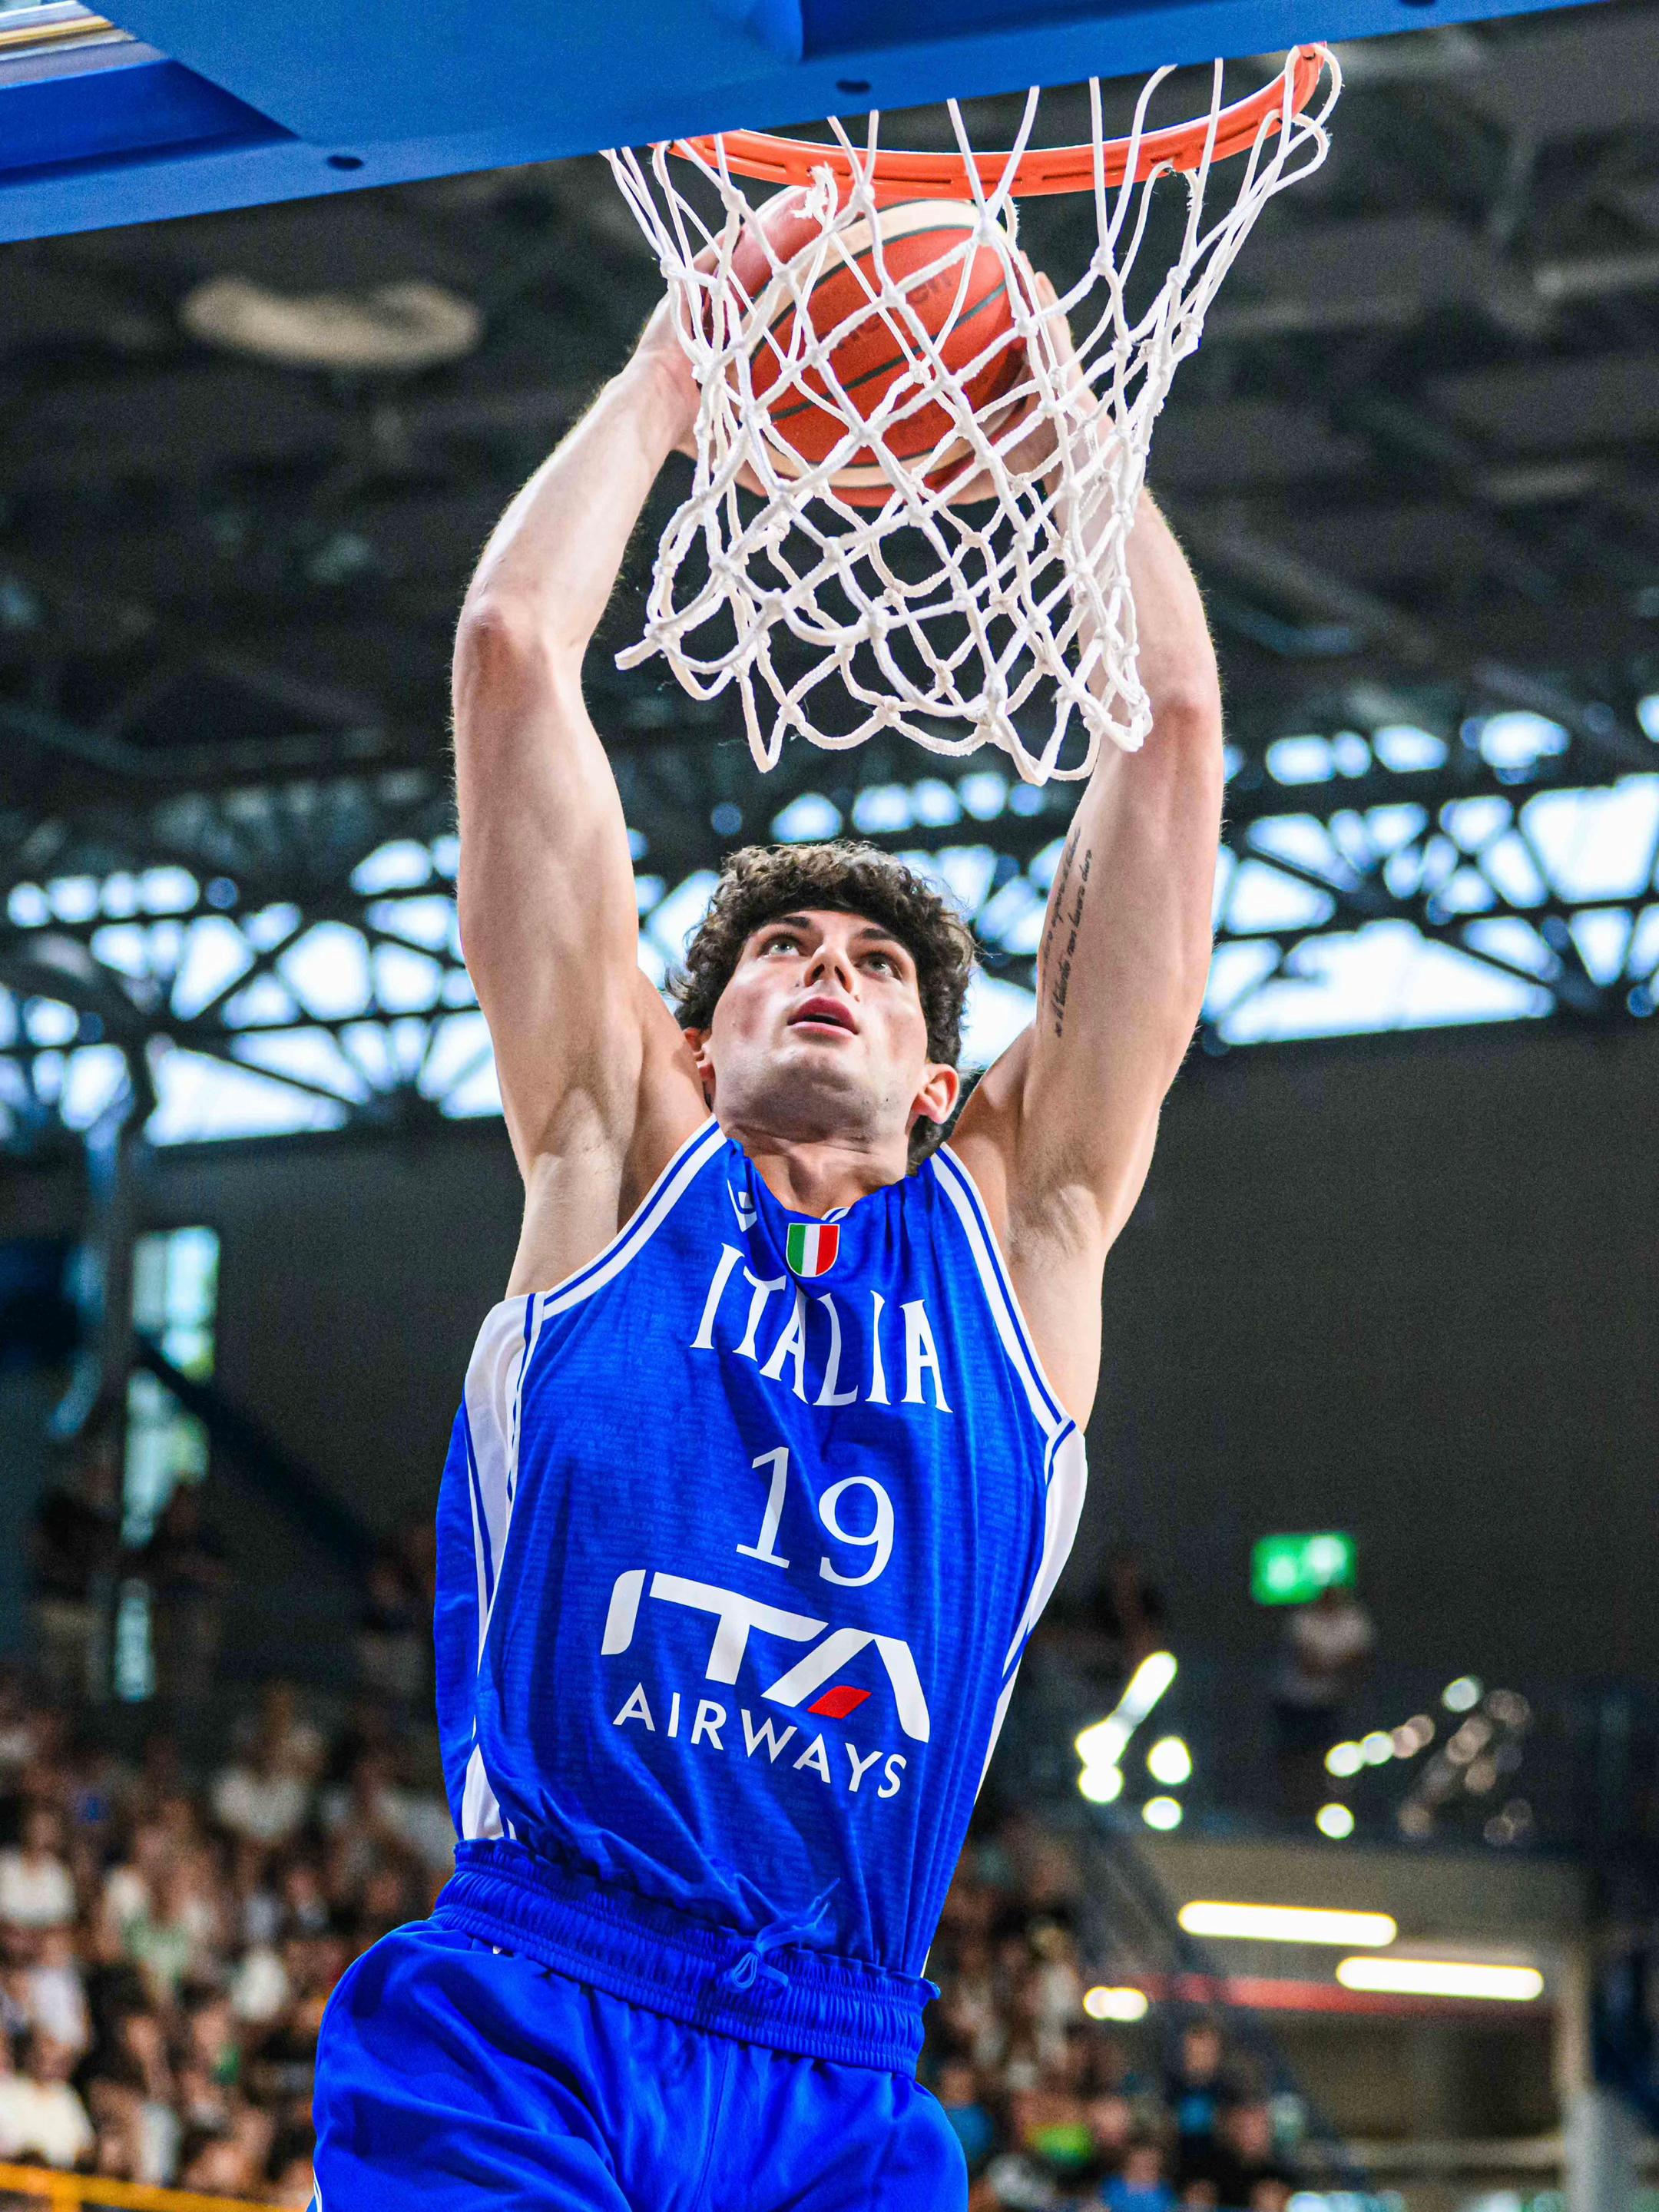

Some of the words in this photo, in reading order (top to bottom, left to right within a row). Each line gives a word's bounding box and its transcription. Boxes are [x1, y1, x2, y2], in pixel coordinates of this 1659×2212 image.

[690, 1243, 953, 1413] ITALIA
[737, 1447, 895, 1587] 19
[601, 1570, 929, 1743] ITA
[613, 1683, 906, 1799] AIRWAYS
